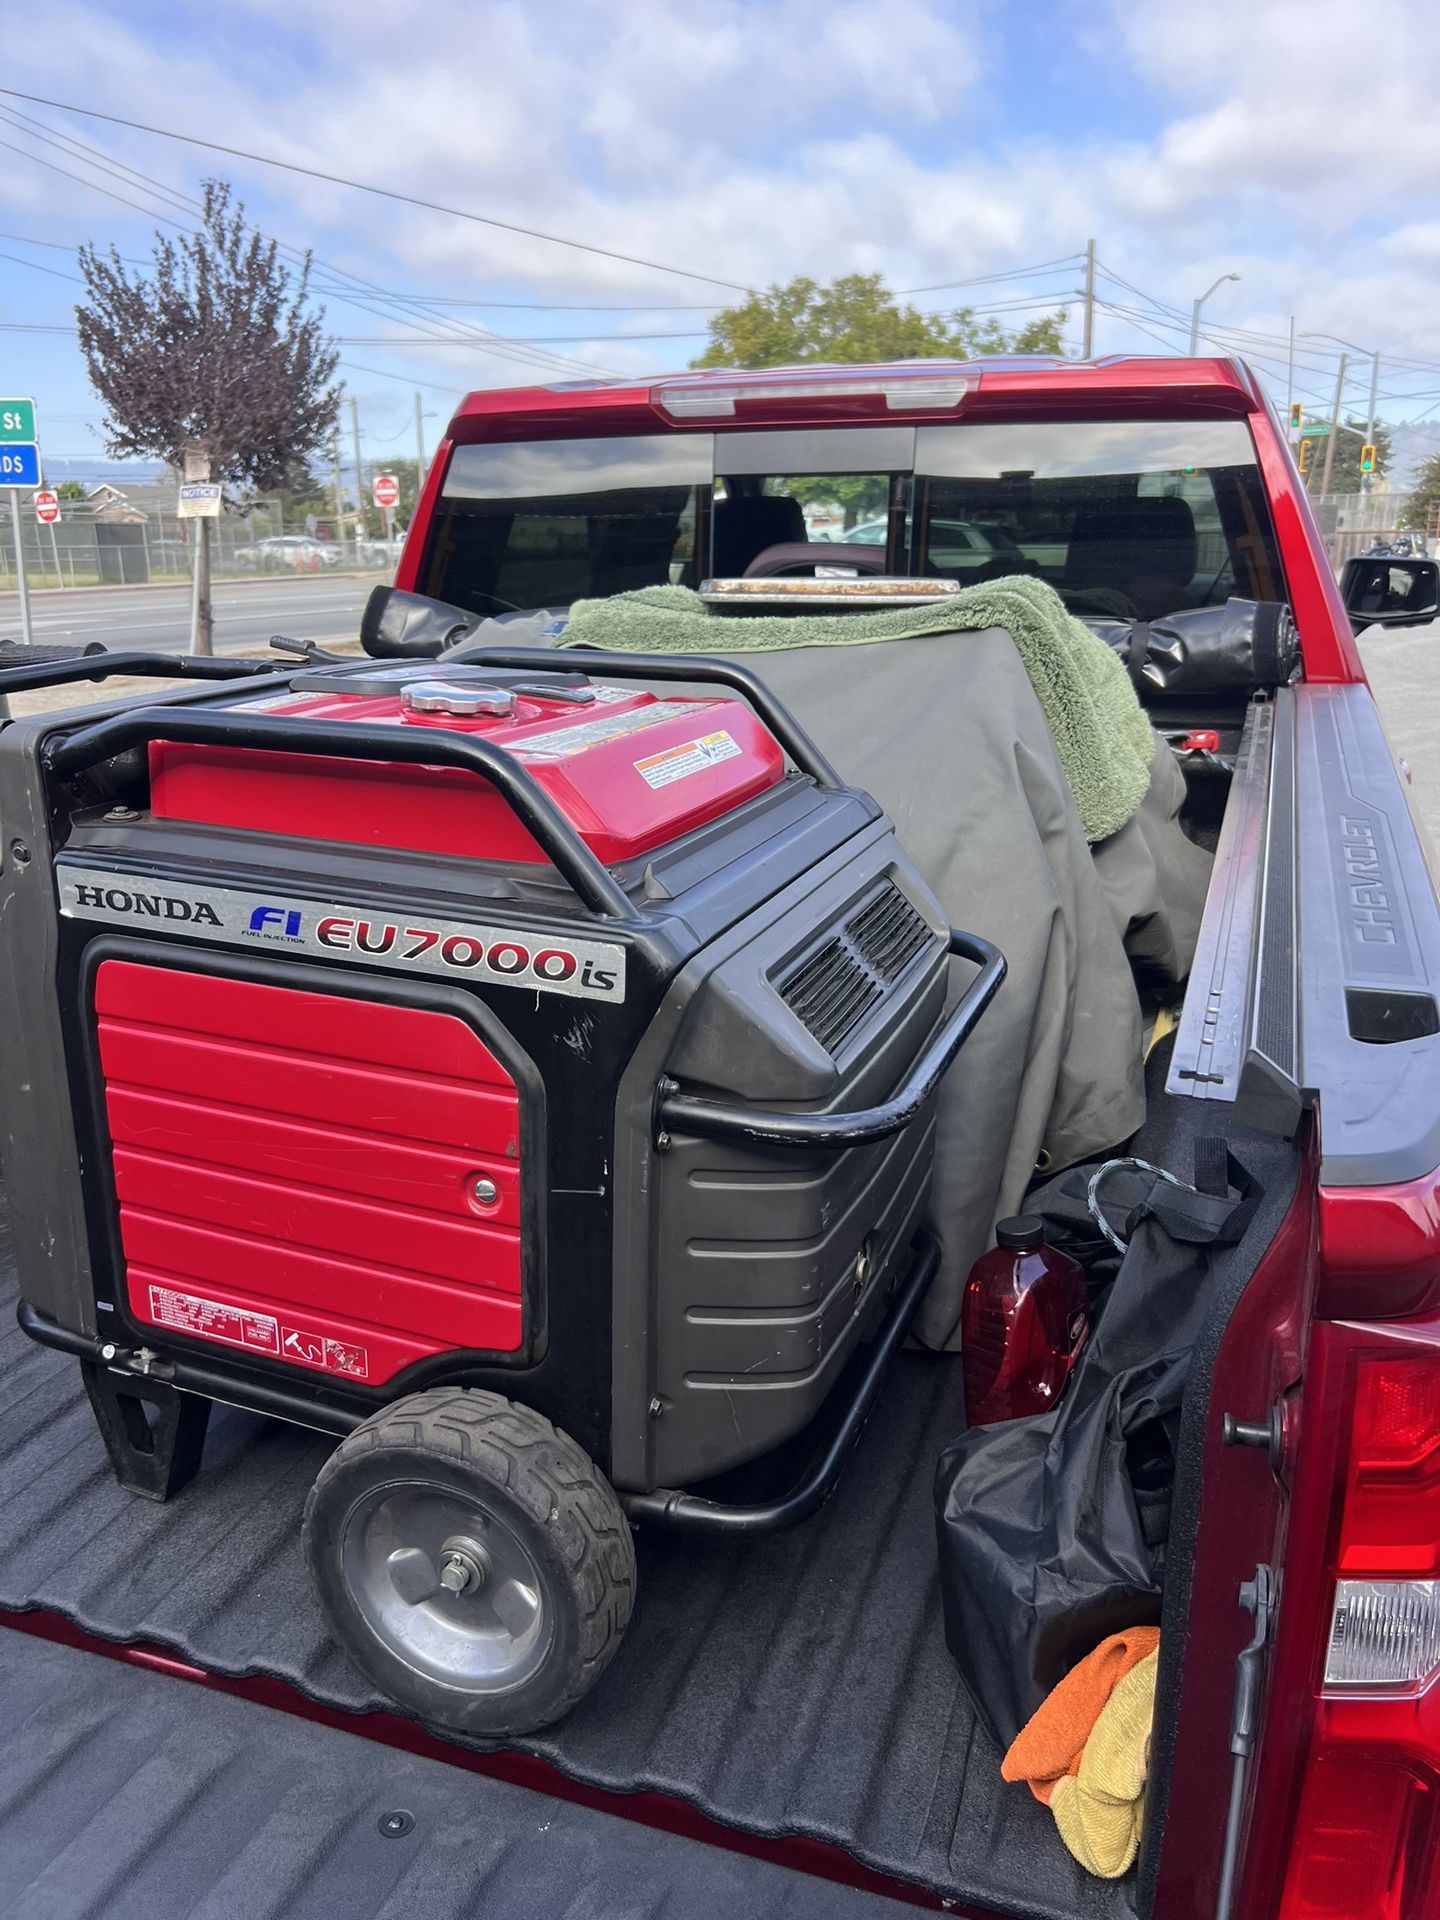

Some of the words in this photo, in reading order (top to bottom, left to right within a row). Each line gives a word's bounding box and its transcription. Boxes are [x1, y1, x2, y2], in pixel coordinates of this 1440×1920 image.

[3, 412, 22, 430] St
[0, 455, 23, 473] DS
[182, 488, 218, 498] NOTICE
[1339, 814, 1398, 944] CHEVROLET
[75, 884, 224, 927] HONDA
[249, 906, 302, 937] FI
[241, 930, 262, 938] FUEL
[263, 934, 305, 944] INJECTION
